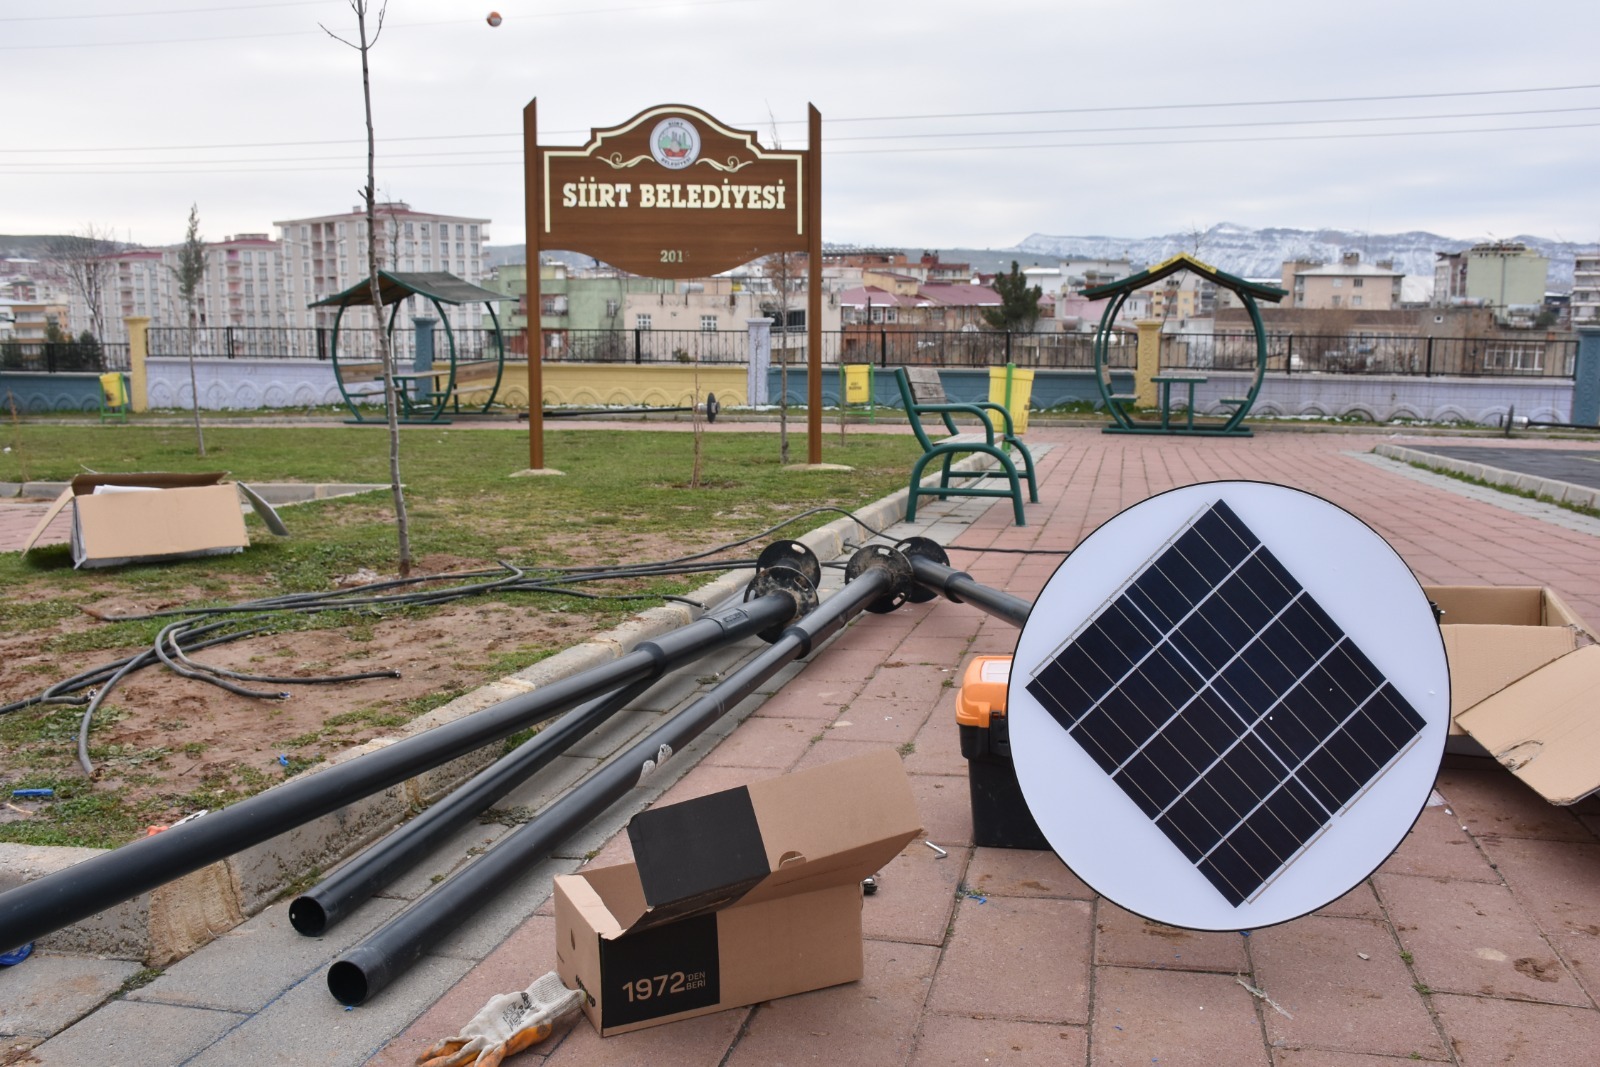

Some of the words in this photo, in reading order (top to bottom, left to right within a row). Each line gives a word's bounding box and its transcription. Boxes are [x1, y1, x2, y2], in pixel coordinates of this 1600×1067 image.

[562, 176, 632, 208] SİİRT
[639, 178, 786, 210] BELEDİYESİ
[660, 249, 690, 263] 201
[622, 971, 685, 1003] 1972
